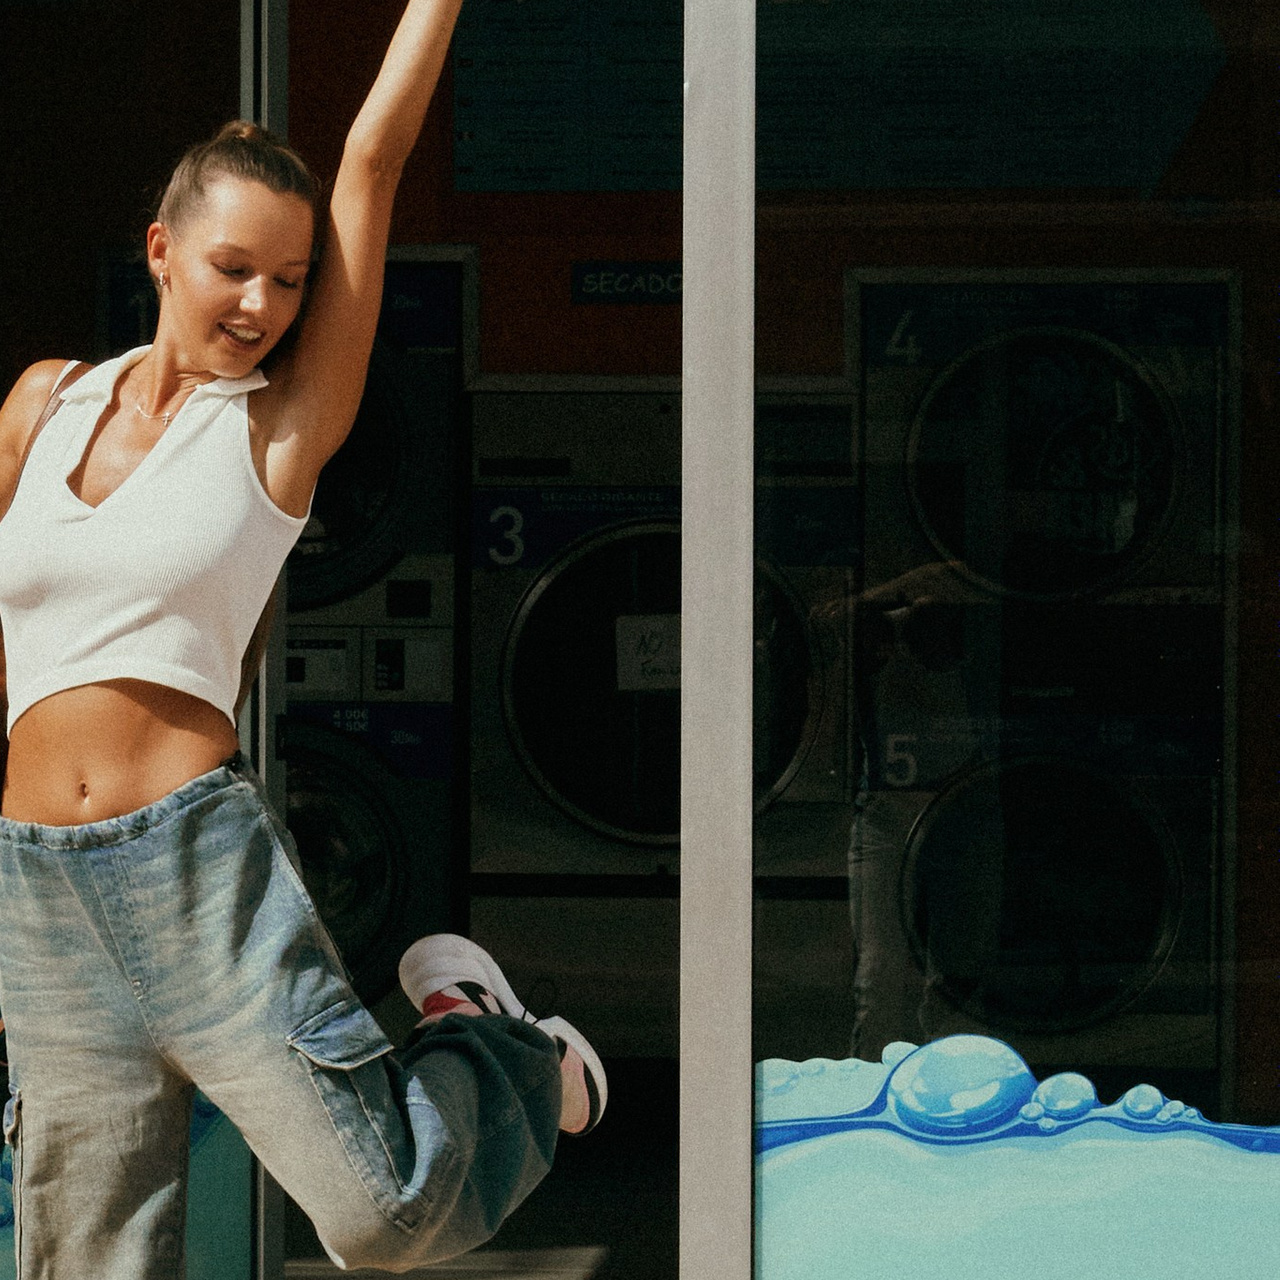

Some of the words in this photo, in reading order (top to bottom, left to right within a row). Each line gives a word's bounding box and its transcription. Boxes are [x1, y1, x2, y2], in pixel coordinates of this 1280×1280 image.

[883, 309, 923, 365] 4
[488, 505, 525, 565] 3
[885, 733, 919, 788] 5
